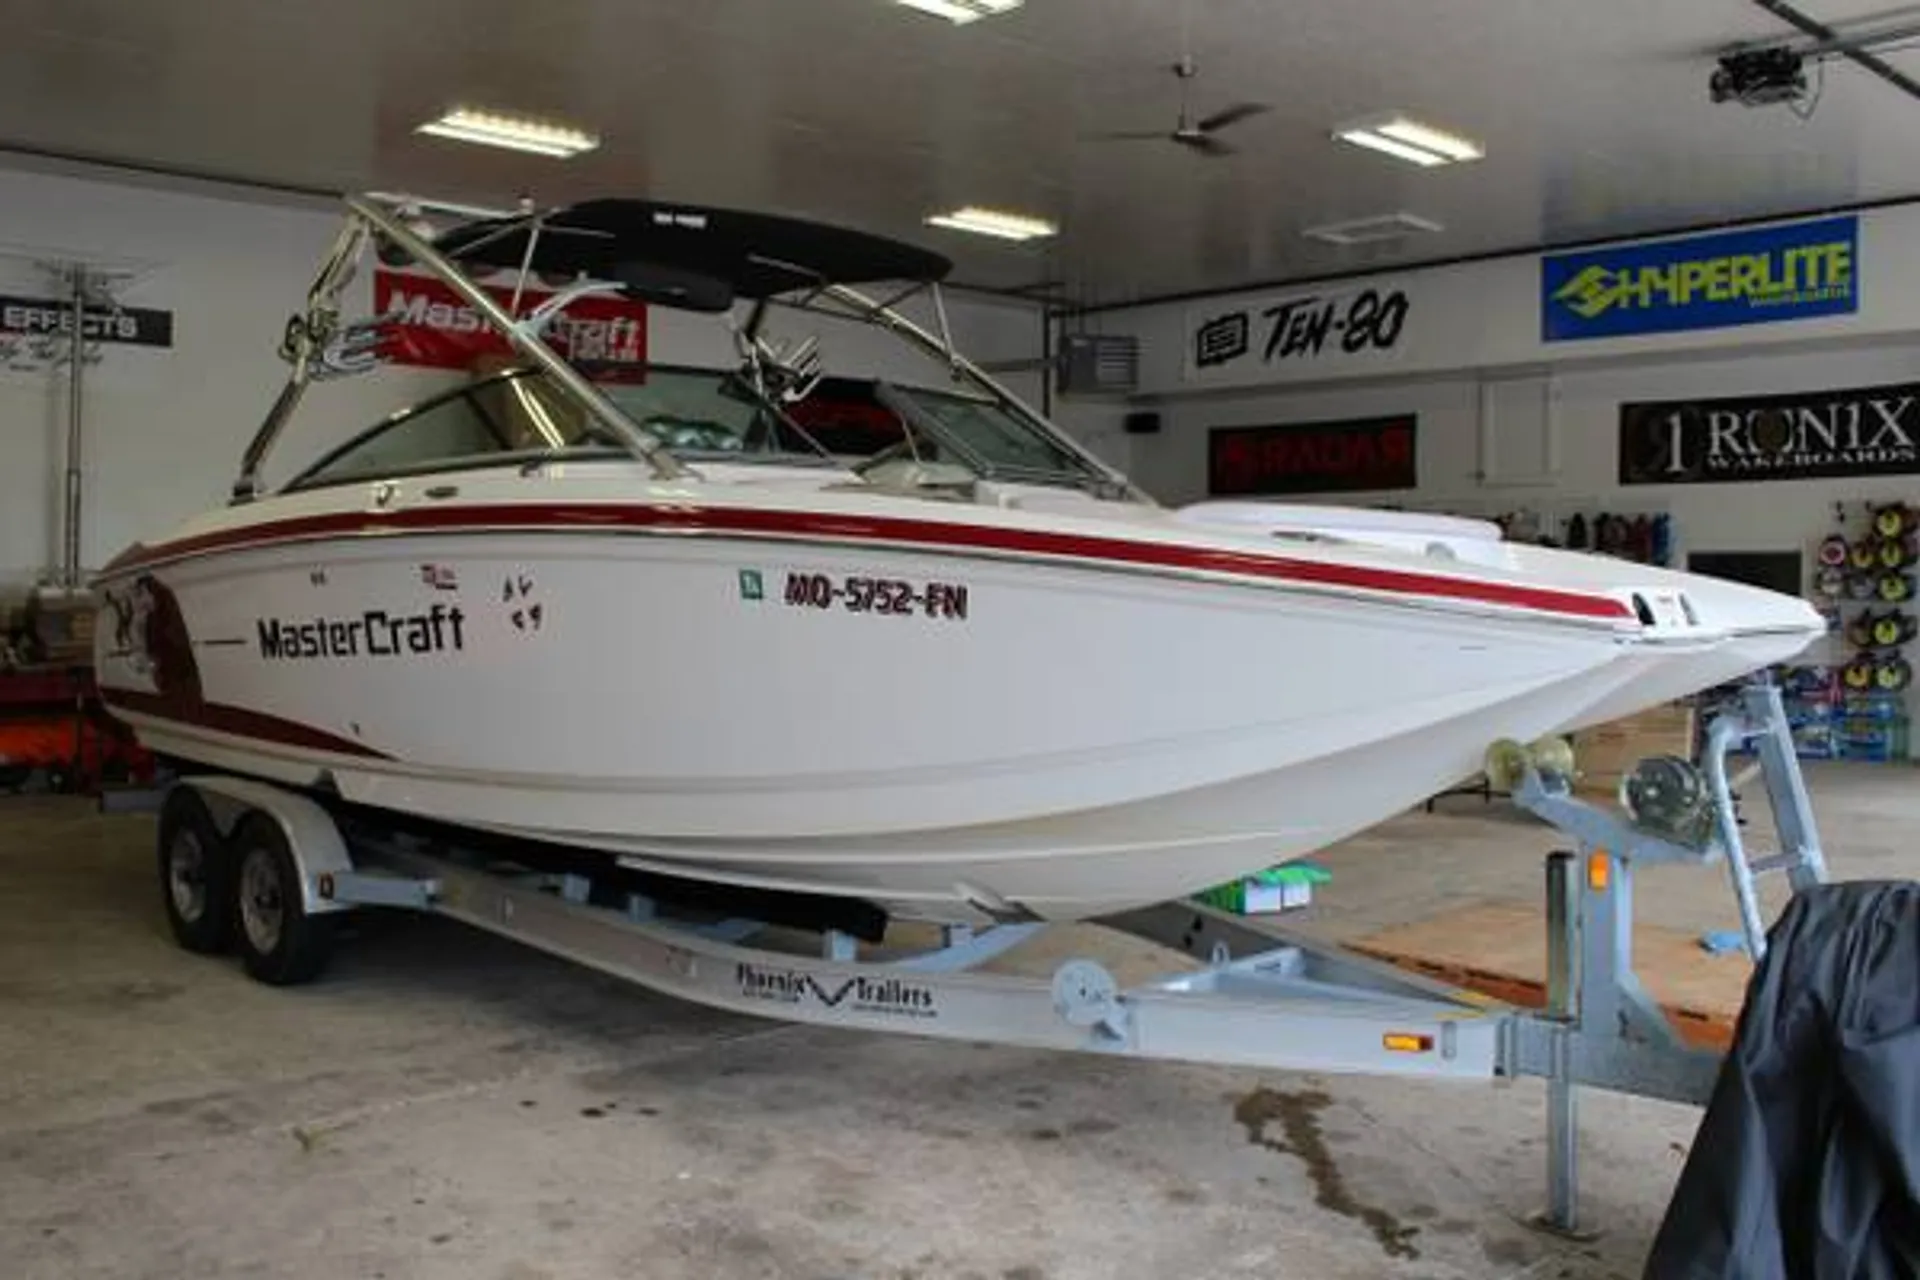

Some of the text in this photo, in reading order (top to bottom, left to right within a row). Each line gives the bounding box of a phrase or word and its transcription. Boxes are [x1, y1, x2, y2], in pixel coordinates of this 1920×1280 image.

[1616, 242, 1851, 310] HYPERLITE
[4, 305, 139, 339] EFFECTS
[387, 290, 640, 355] MasCraft
[1262, 289, 1409, 361] TEN-80
[1708, 397, 1914, 455] RONIX
[257, 604, 464, 659] MasterCraft
[737, 963, 933, 1006] Phoenix Trailers
